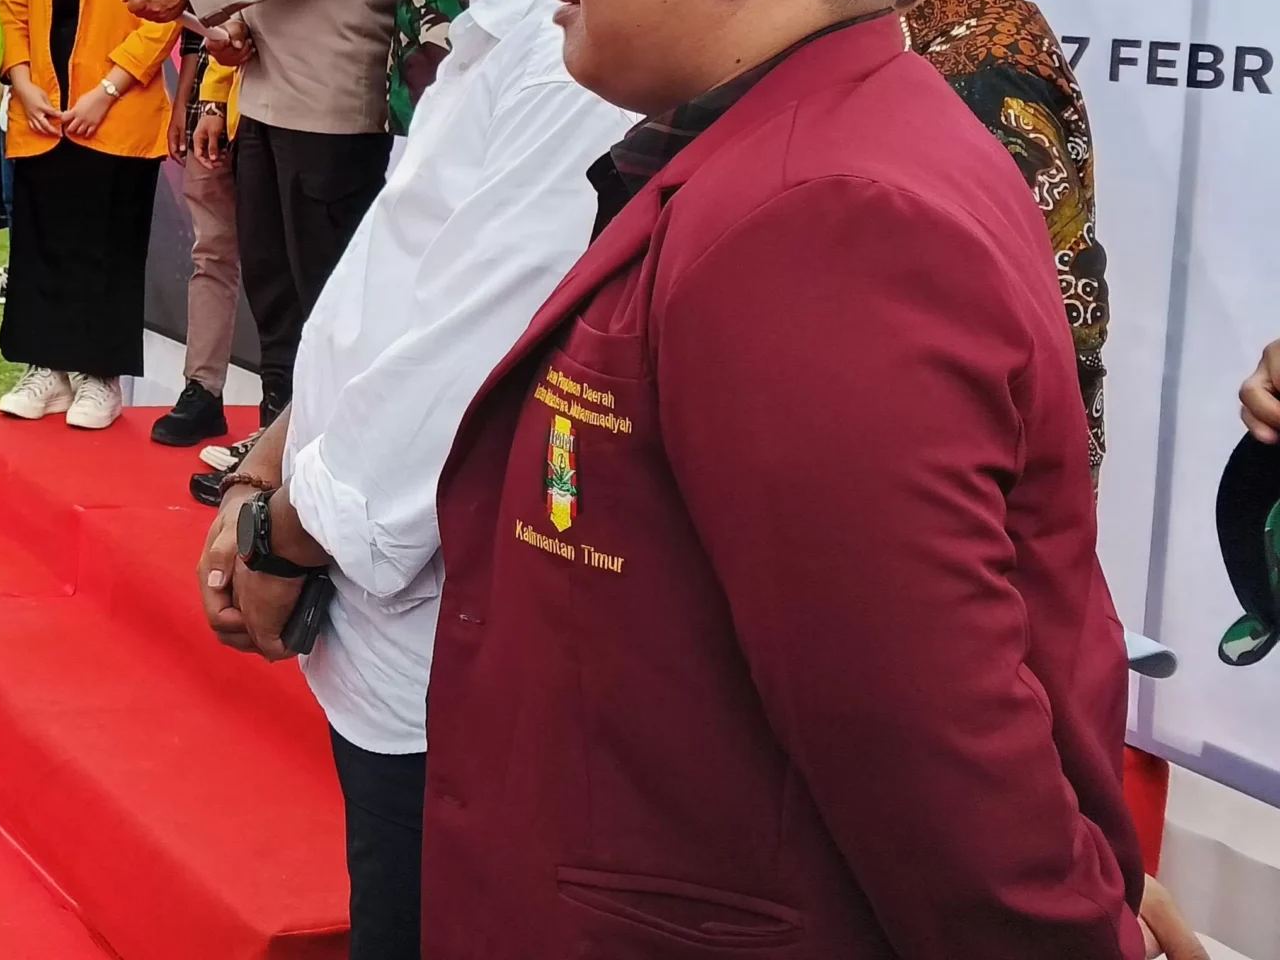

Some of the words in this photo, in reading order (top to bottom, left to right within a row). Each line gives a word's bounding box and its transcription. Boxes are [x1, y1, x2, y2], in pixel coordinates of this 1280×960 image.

[582, 383, 615, 409] Daerah
[515, 519, 575, 561] Kalimantan
[581, 544, 625, 574] Timur
